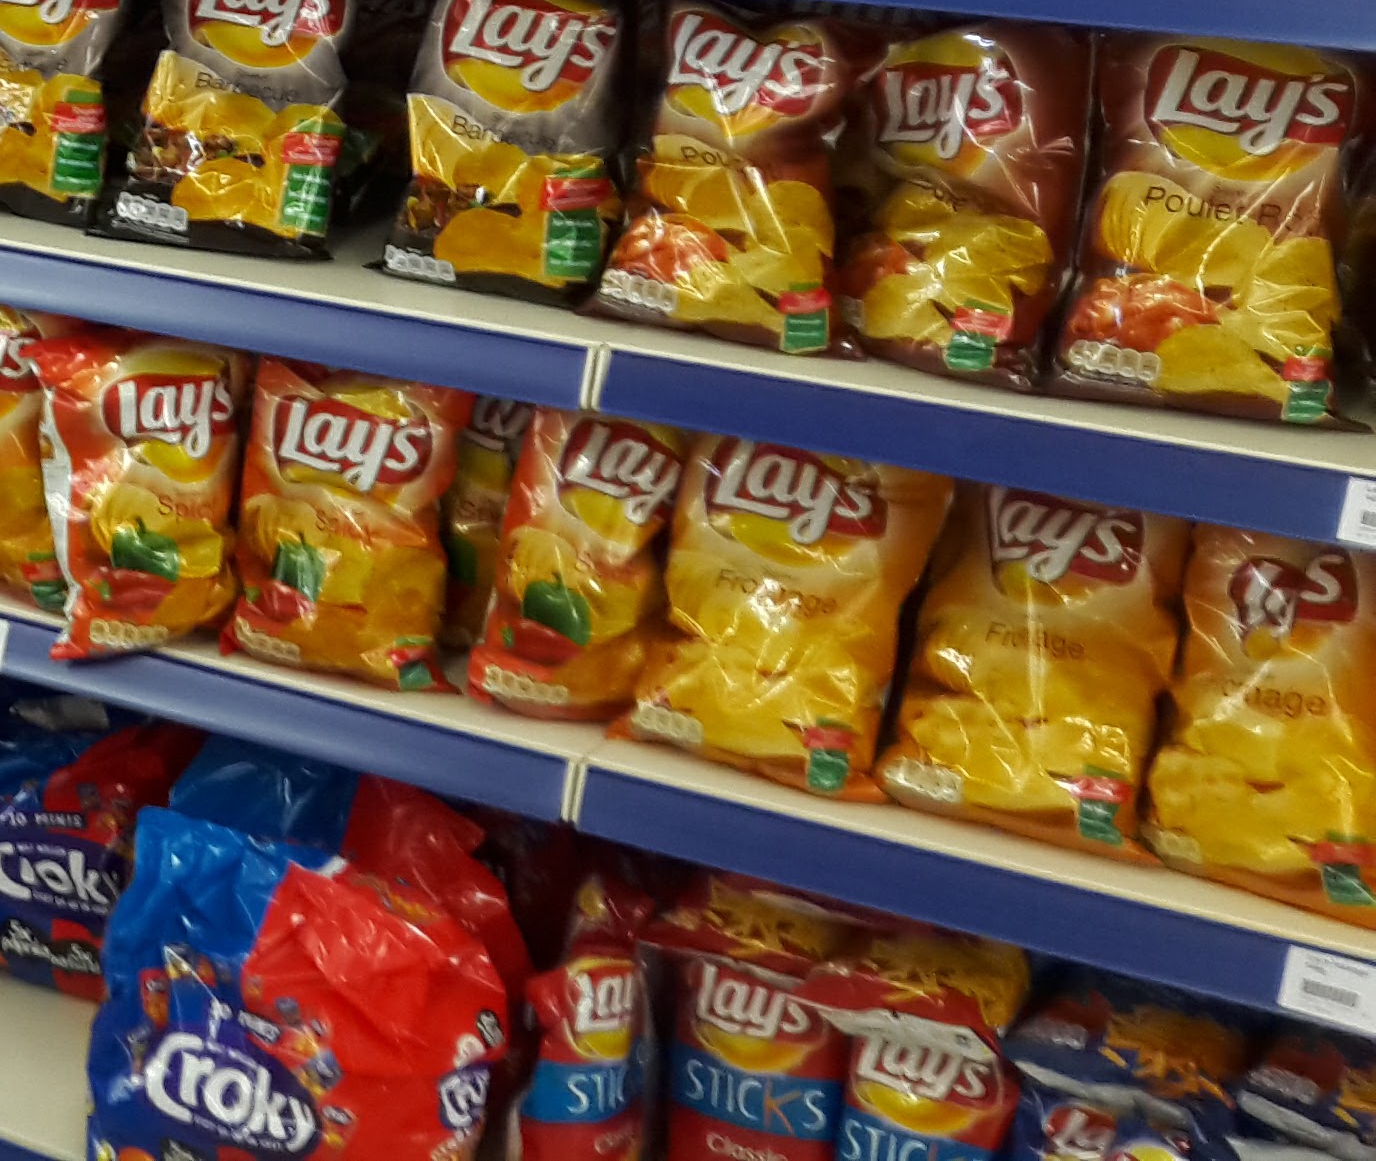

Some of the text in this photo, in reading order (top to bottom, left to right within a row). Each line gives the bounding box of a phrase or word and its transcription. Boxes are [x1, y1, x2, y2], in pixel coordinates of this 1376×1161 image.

[668, 13, 830, 116] Lay's
[880, 58, 1011, 159] Lay's
[1149, 48, 1349, 157] Lay's
[116, 372, 235, 459] Lay's
[278, 398, 434, 493] Lay's
[713, 439, 876, 545] Lay's
[34, 811, 85, 829] MINIS
[697, 960, 812, 1040] Lay's
[144, 1032, 316, 1154] Croky
[685, 1059, 828, 1136] STICKS
